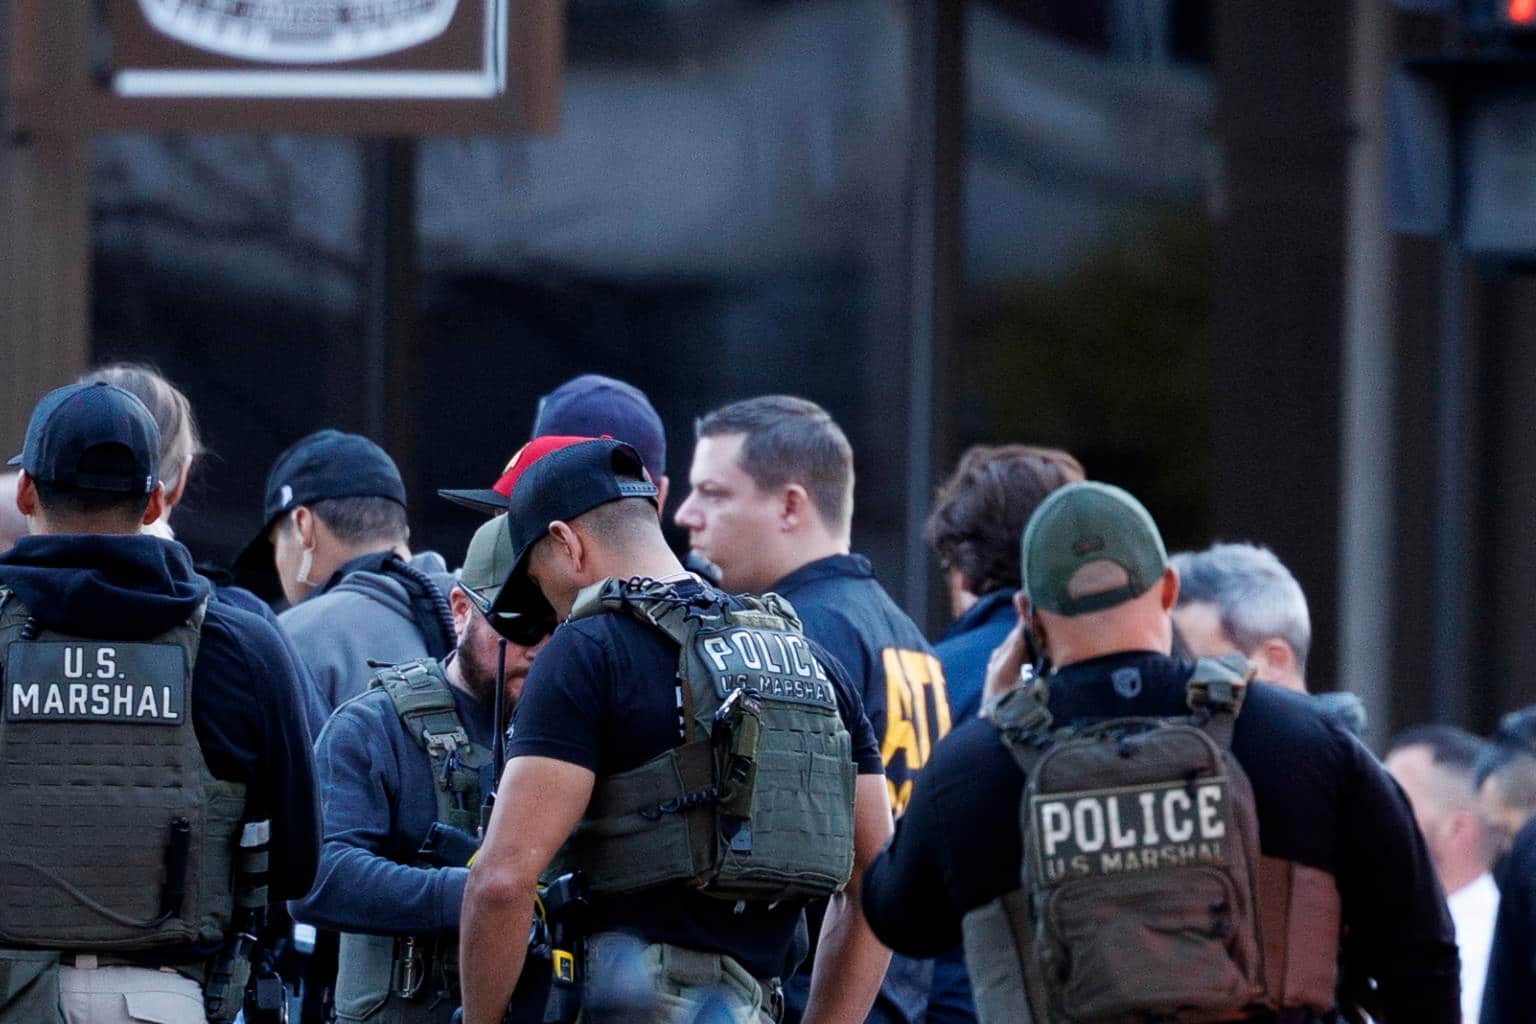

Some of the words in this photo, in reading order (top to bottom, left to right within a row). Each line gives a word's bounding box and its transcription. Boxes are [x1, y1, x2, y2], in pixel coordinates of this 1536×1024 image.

[64, 647, 125, 679] U.S.
[12, 683, 178, 719] MARSHAL
[1041, 785, 1226, 855] POLICE
[1100, 843, 1223, 874] MARSHAL
